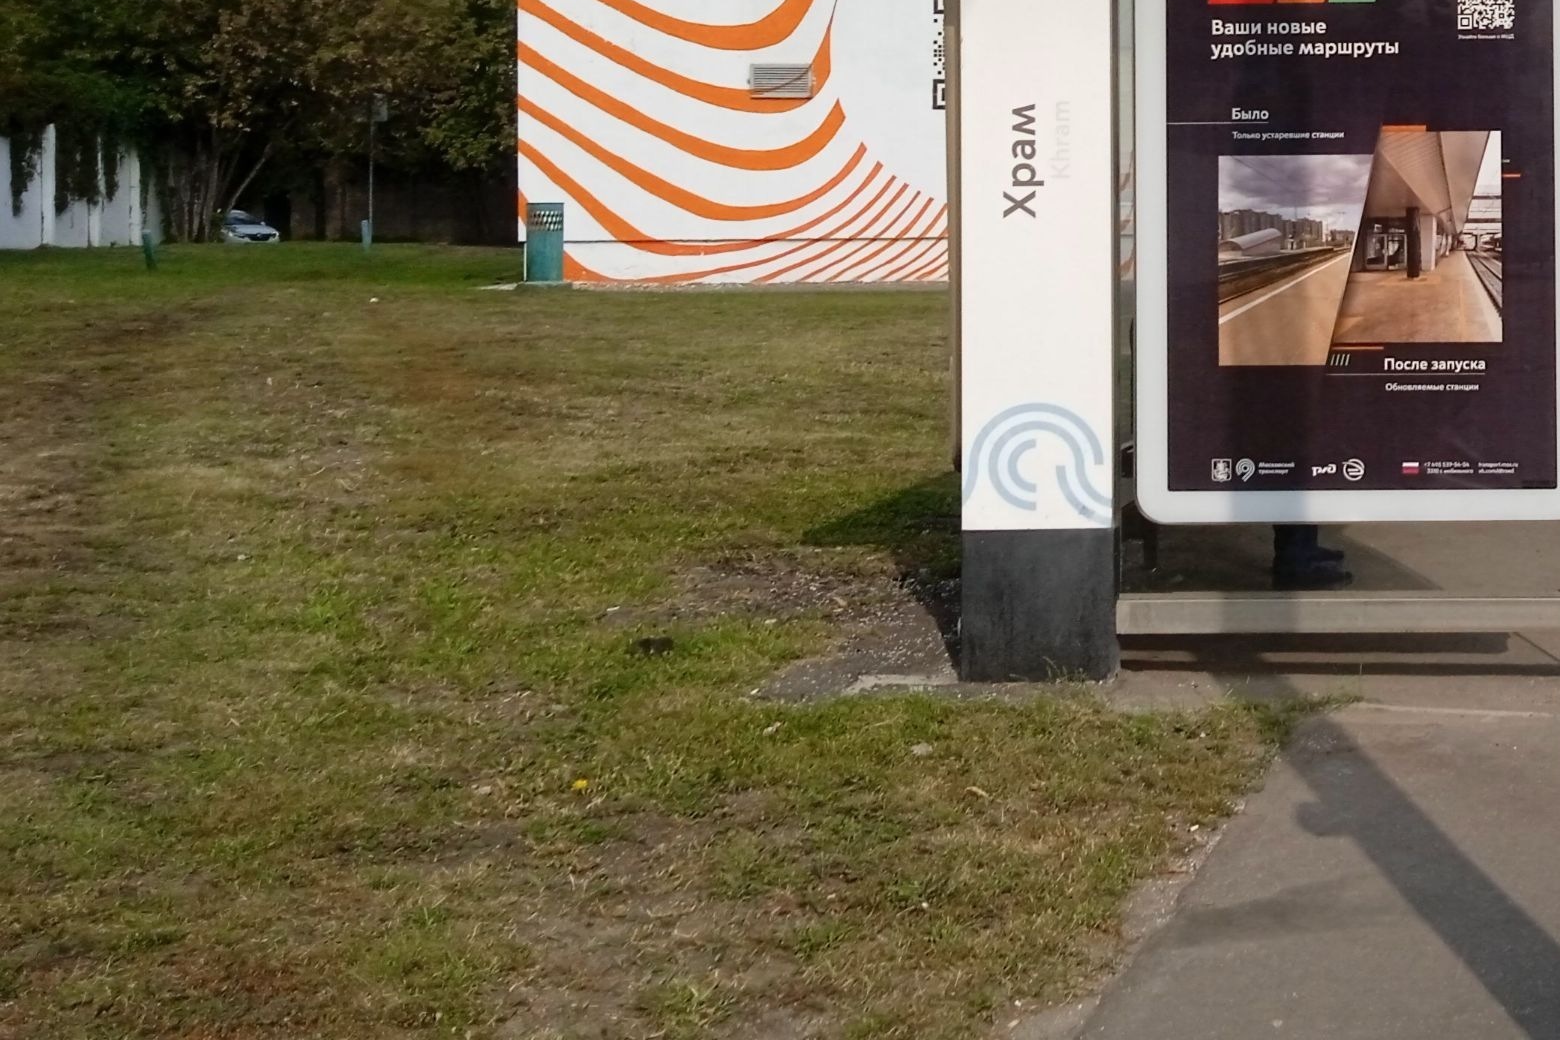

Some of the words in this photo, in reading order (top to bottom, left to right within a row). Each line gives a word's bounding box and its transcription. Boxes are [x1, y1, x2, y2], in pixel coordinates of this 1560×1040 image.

[1211, 19, 1262, 36] Ваши
[1266, 20, 1327, 35] новые
[1210, 39, 1294, 60] удобные
[1298, 40, 1400, 59] маршруты
[1231, 107, 1269, 120] Было
[1049, 100, 1071, 179] Khram
[1232, 131, 1261, 139] Только
[1262, 132, 1311, 141] устаревшие
[1311, 131, 1345, 139] станции
[1002, 103, 1045, 219] Храм
[1383, 357, 1428, 371] После
[1430, 359, 1486, 373] запуска
[1385, 382, 1445, 391] Обновляемые
[1445, 383, 1480, 392] станции
